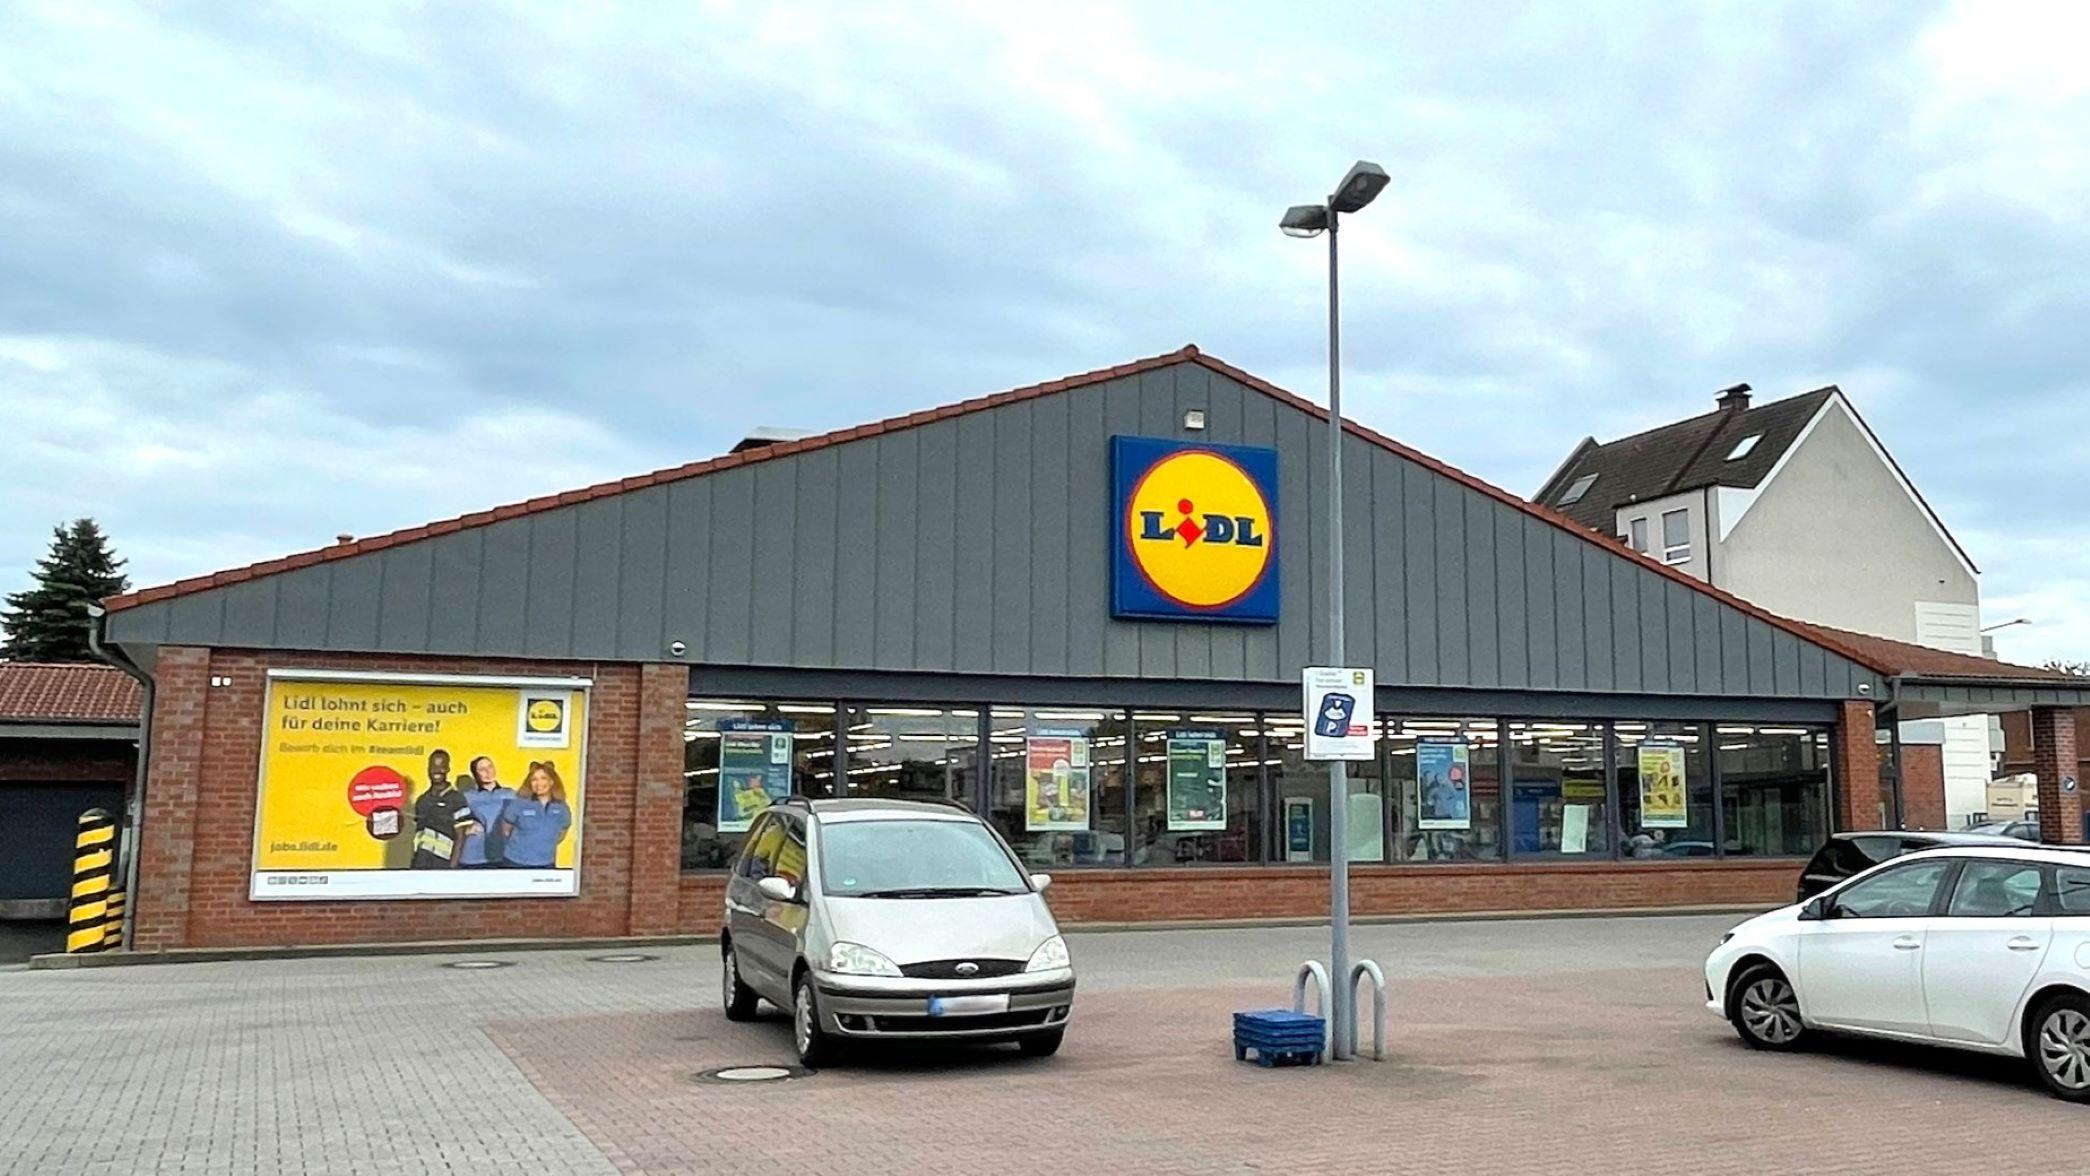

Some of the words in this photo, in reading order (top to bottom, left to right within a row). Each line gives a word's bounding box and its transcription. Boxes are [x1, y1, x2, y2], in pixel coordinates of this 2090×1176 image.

[284, 695, 315, 710] Lidl
[321, 696, 367, 712] lohnt
[372, 699, 407, 712] sich
[426, 702, 468, 714] auch
[282, 716, 307, 730] für
[312, 717, 361, 731] deine
[367, 719, 441, 733] Karriere!
